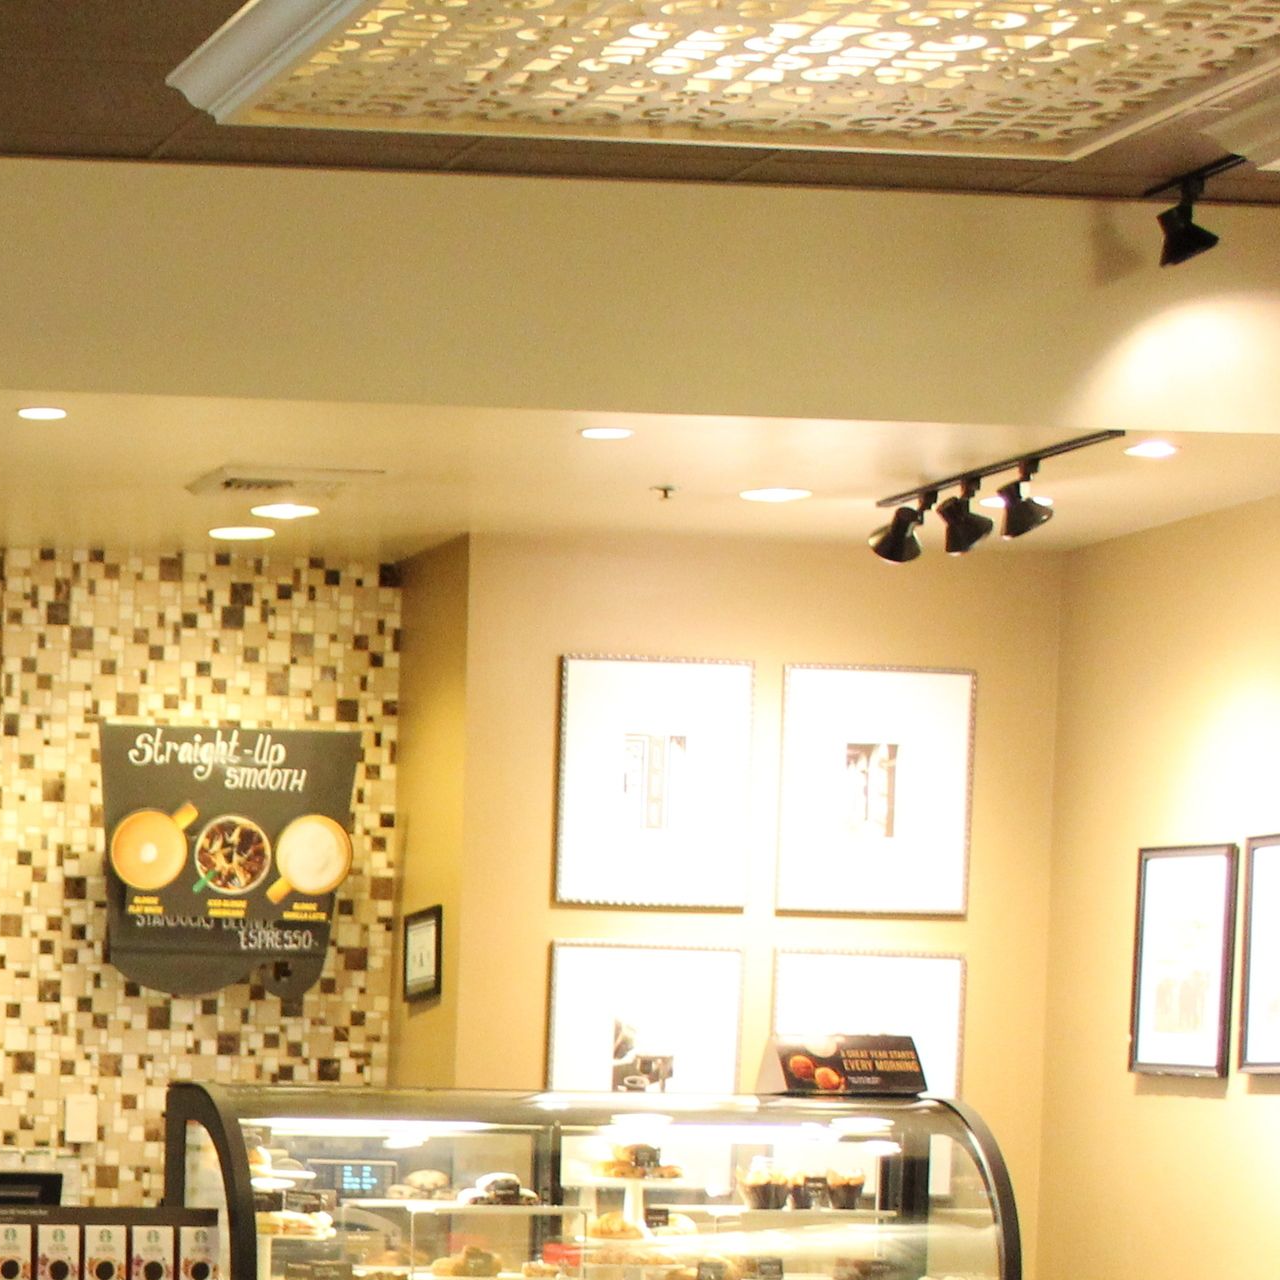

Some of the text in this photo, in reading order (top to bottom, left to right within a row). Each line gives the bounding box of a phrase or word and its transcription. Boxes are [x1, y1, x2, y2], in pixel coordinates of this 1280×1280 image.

[238, 929, 313, 950] ESPRESSO
[843, 1059, 920, 1072] EVERY MORNING
